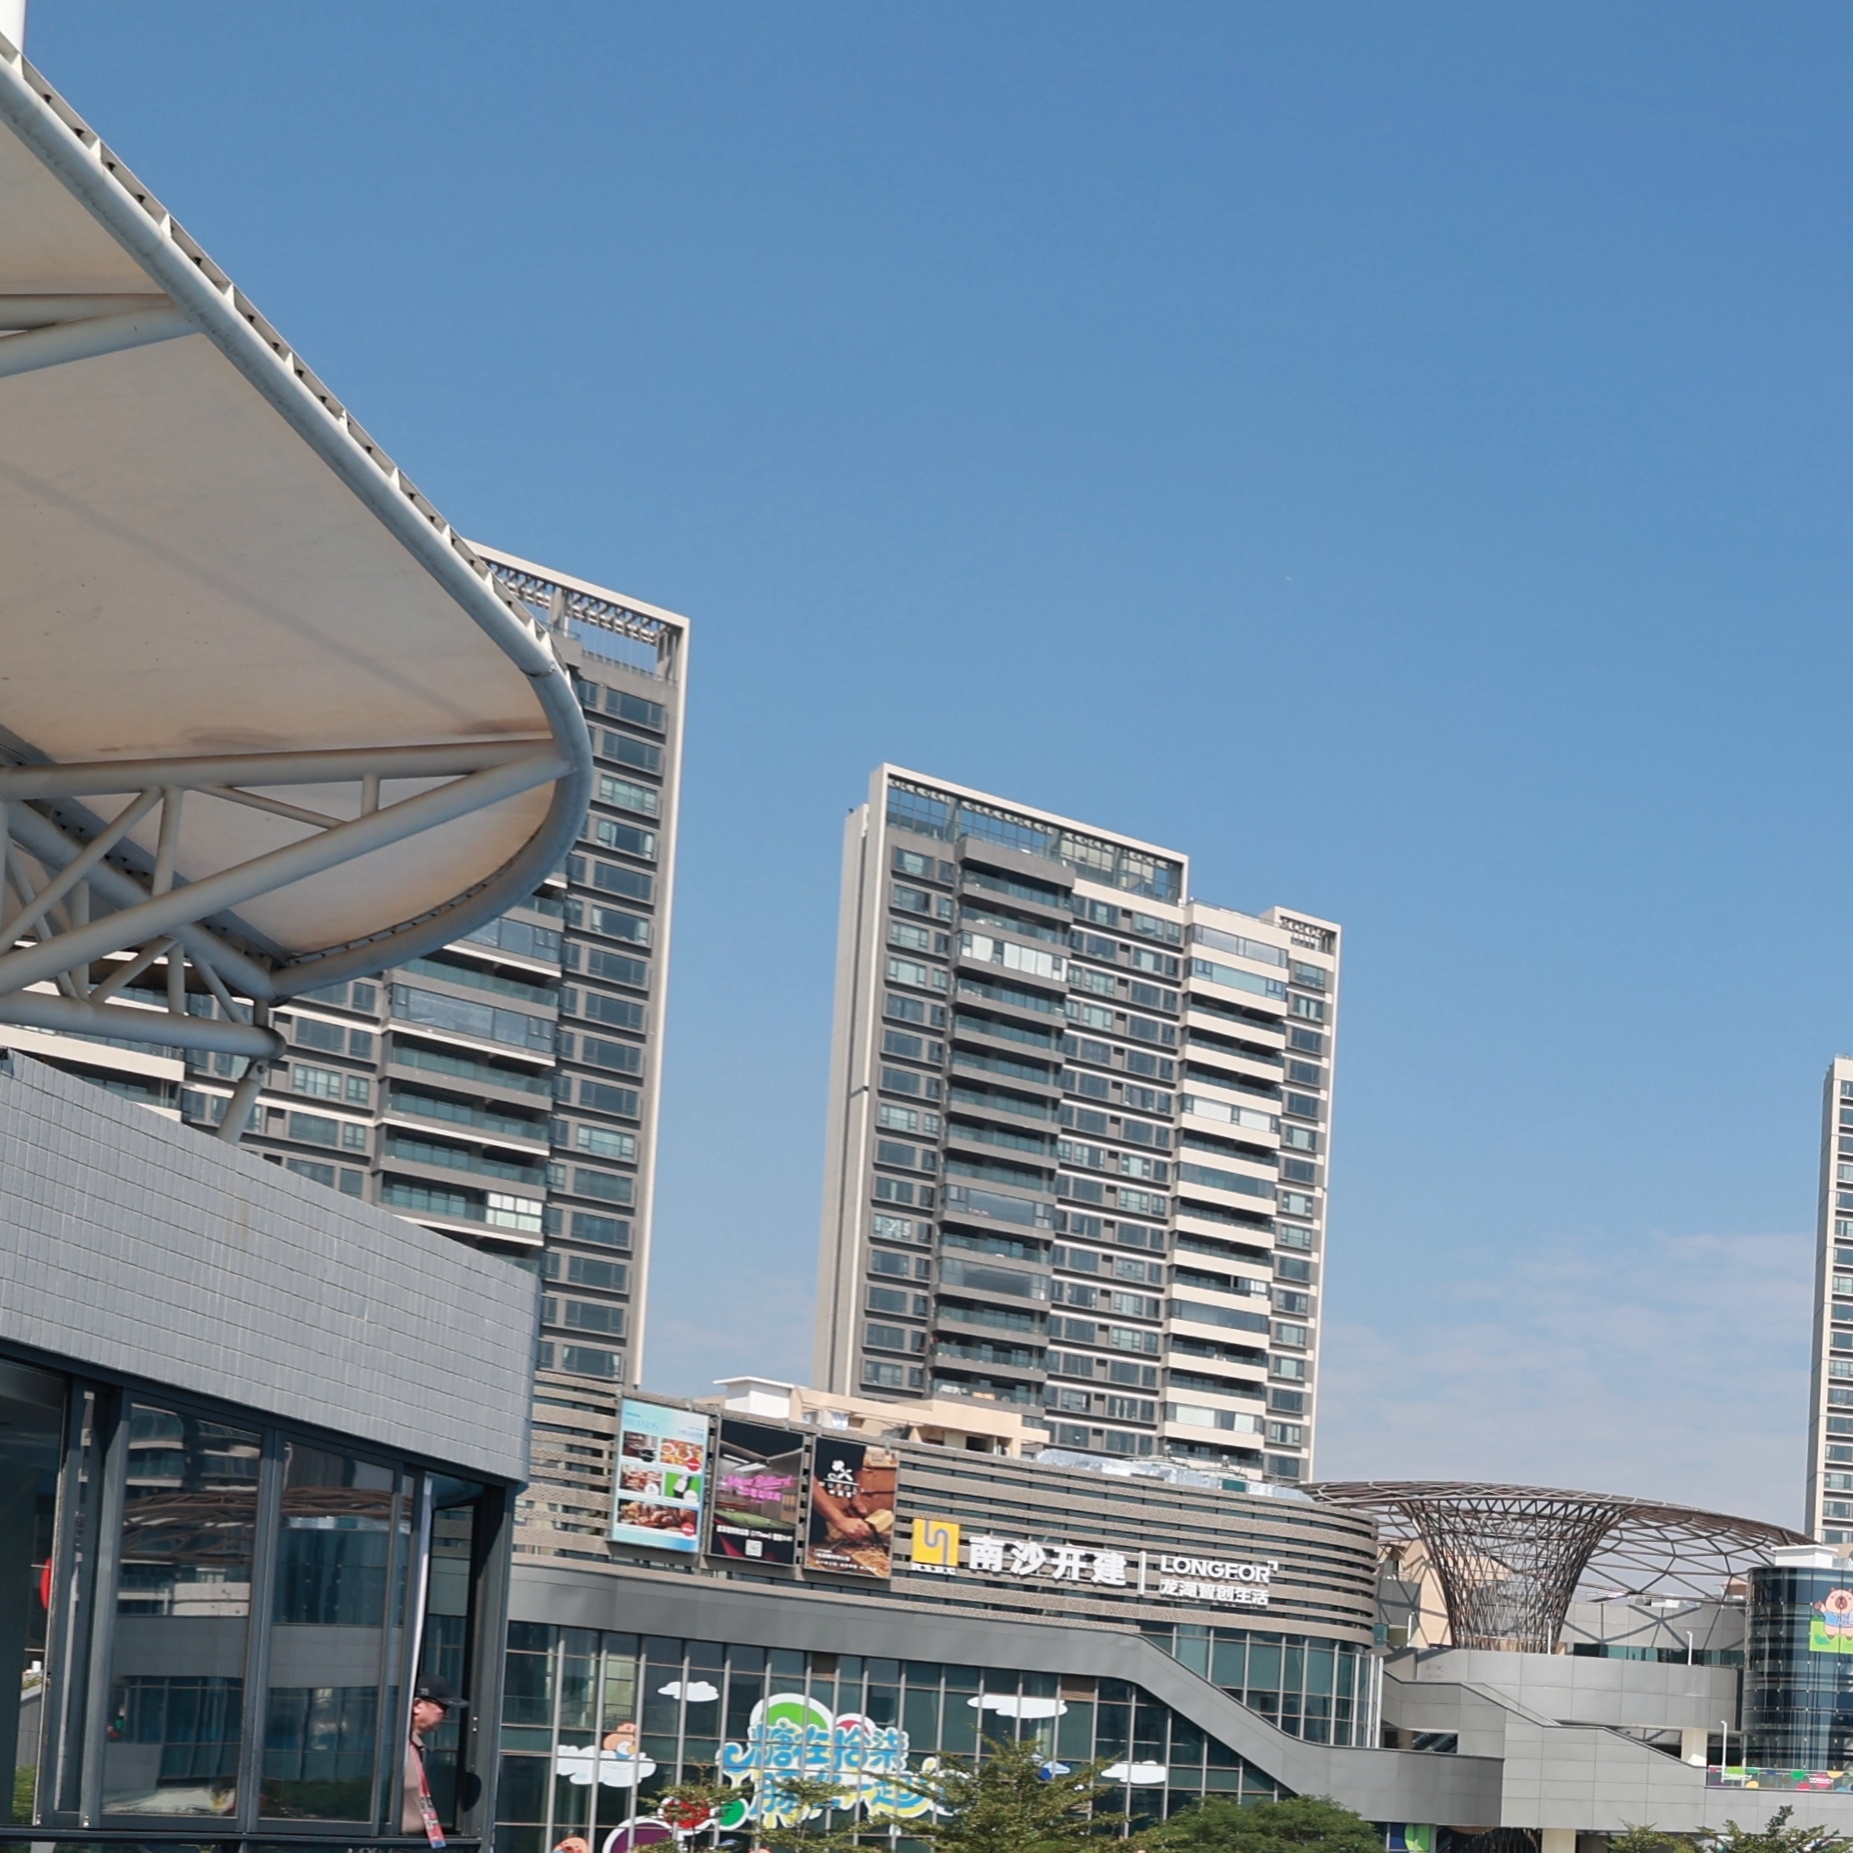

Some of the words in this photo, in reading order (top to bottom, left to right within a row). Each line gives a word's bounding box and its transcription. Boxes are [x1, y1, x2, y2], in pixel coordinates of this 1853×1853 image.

[968, 1535, 1127, 1586] 南沙开建
[1160, 1555, 1271, 1584] LONGFOR
[1160, 1577, 1270, 1606] 龙湖智创生活
